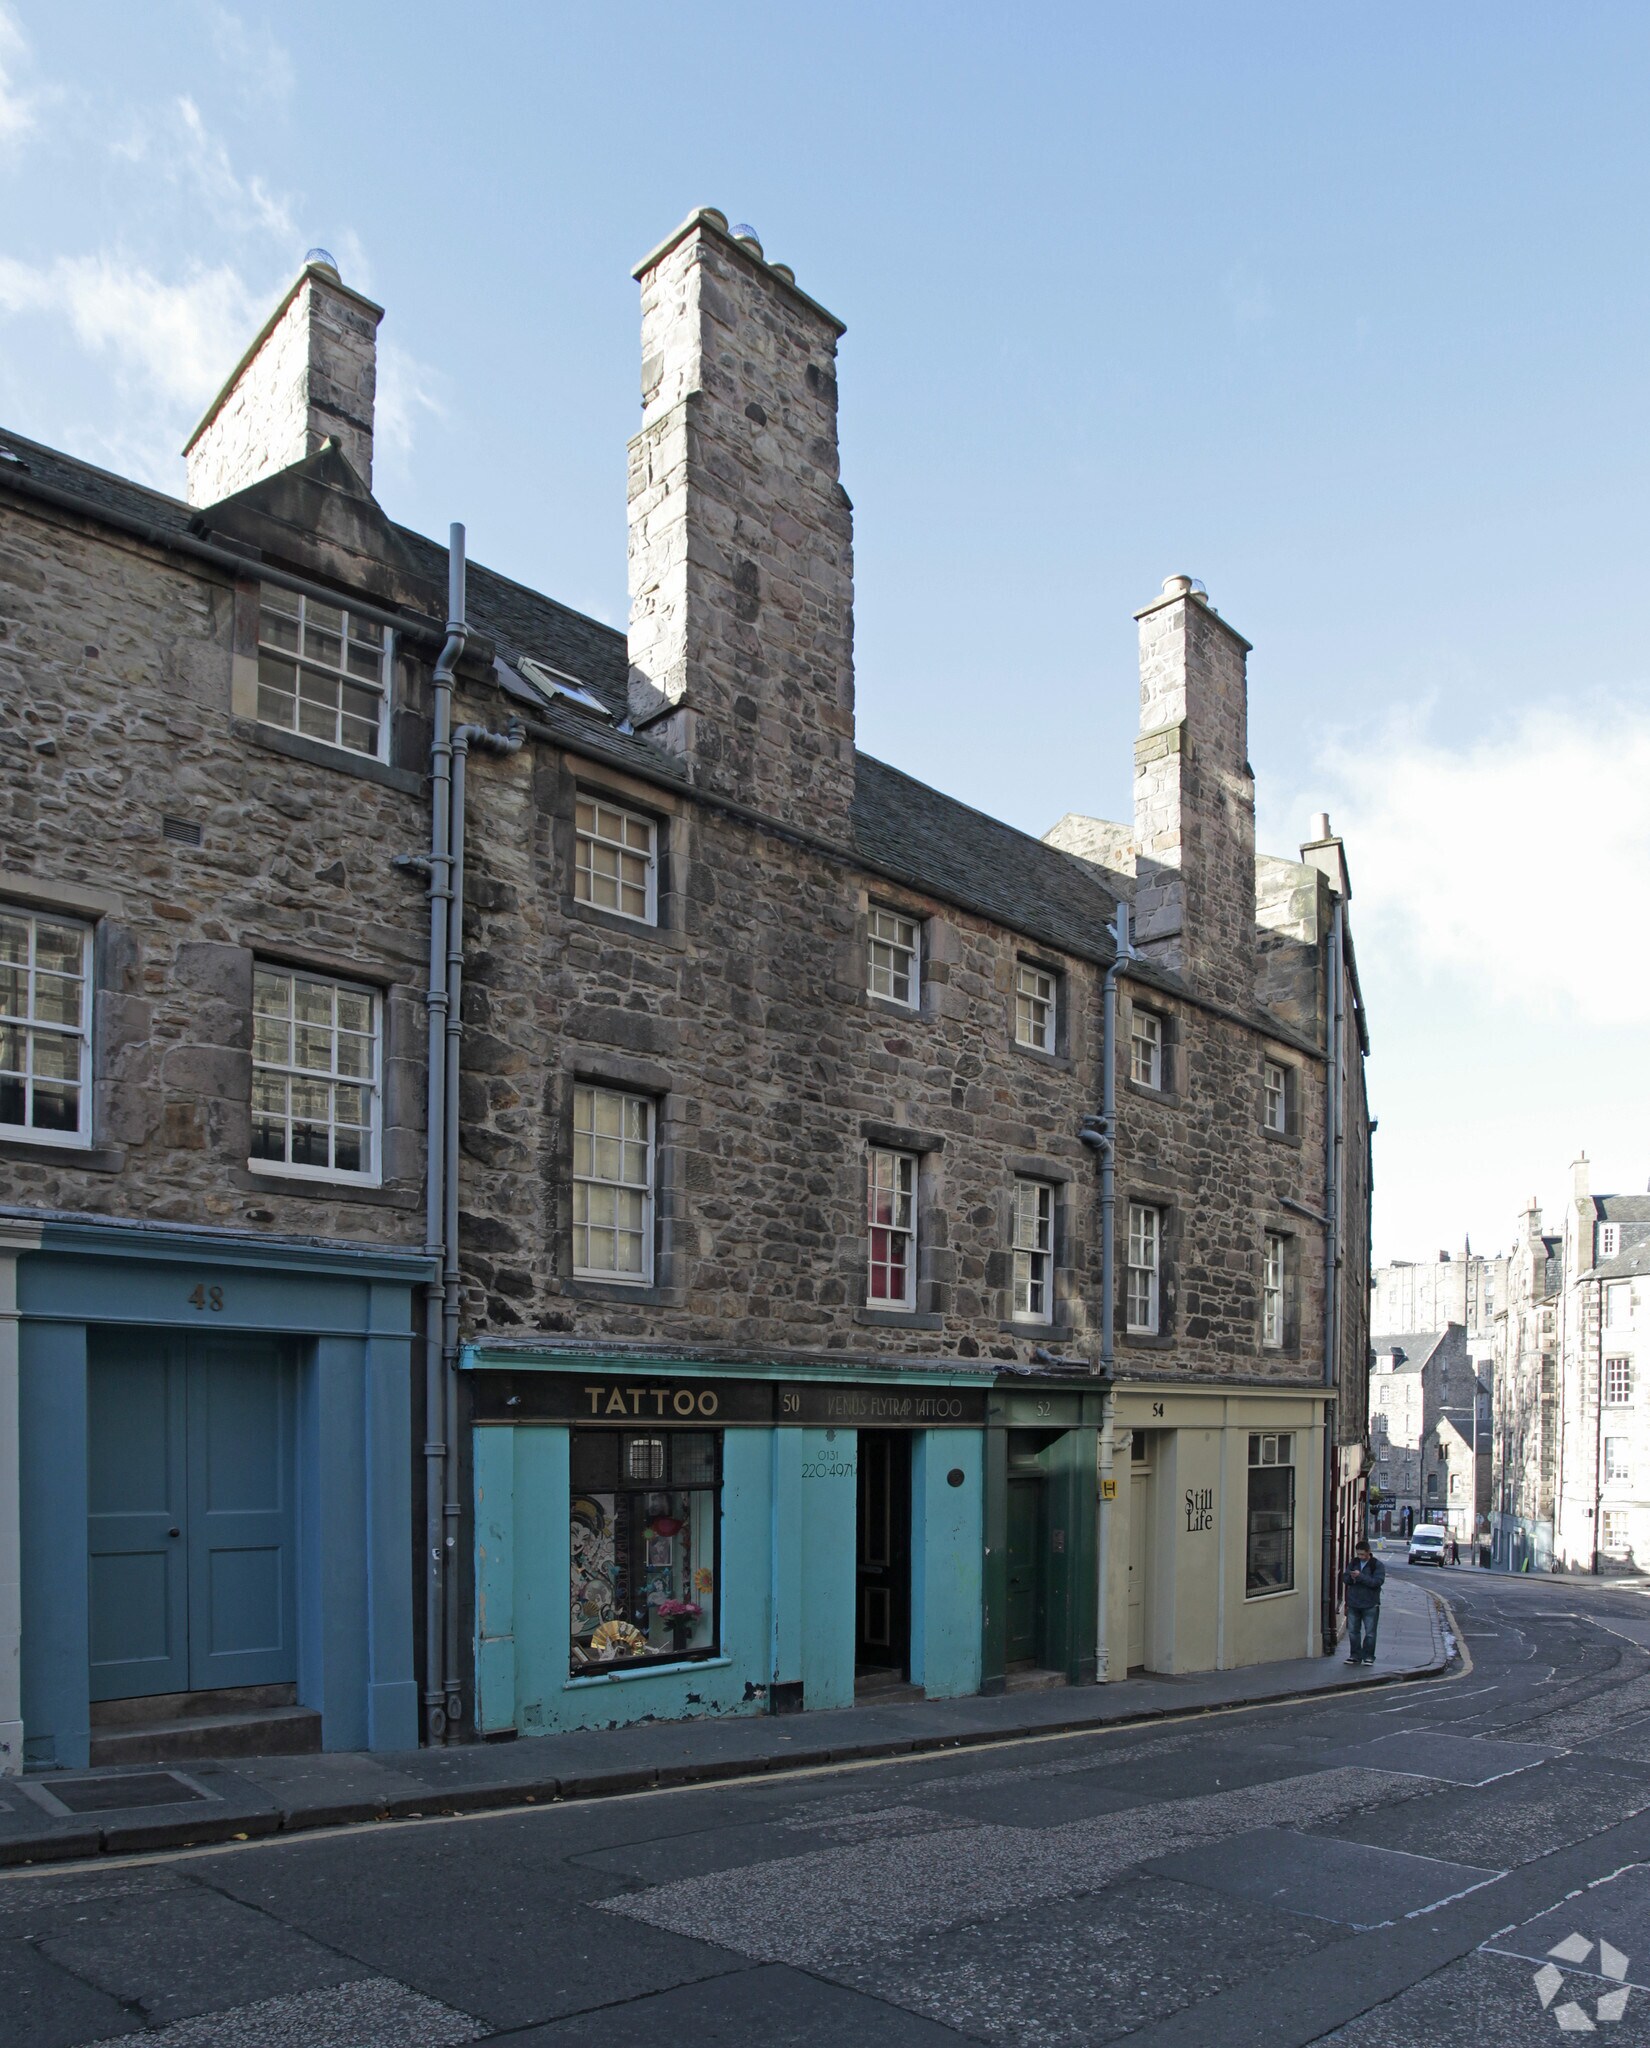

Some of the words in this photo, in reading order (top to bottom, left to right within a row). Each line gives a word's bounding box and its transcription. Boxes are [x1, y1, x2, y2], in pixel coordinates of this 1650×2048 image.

[188, 1283, 224, 1312] 48
[584, 1386, 719, 1416] TATTOO
[783, 1394, 800, 1412] 50
[827, 1395, 867, 1416] VENUS
[871, 1397, 912, 1416] FLYTRAP
[915, 1398, 962, 1417] TATTOO
[1037, 1401, 1050, 1417] 52
[1152, 1402, 1164, 1418] 54
[817, 1450, 839, 1461] 0131
[801, 1463, 853, 1478] 220-4971
[1103, 1481, 1116, 1497] H
[1185, 1488, 1213, 1515] Still
[1186, 1509, 1213, 1532] Life
